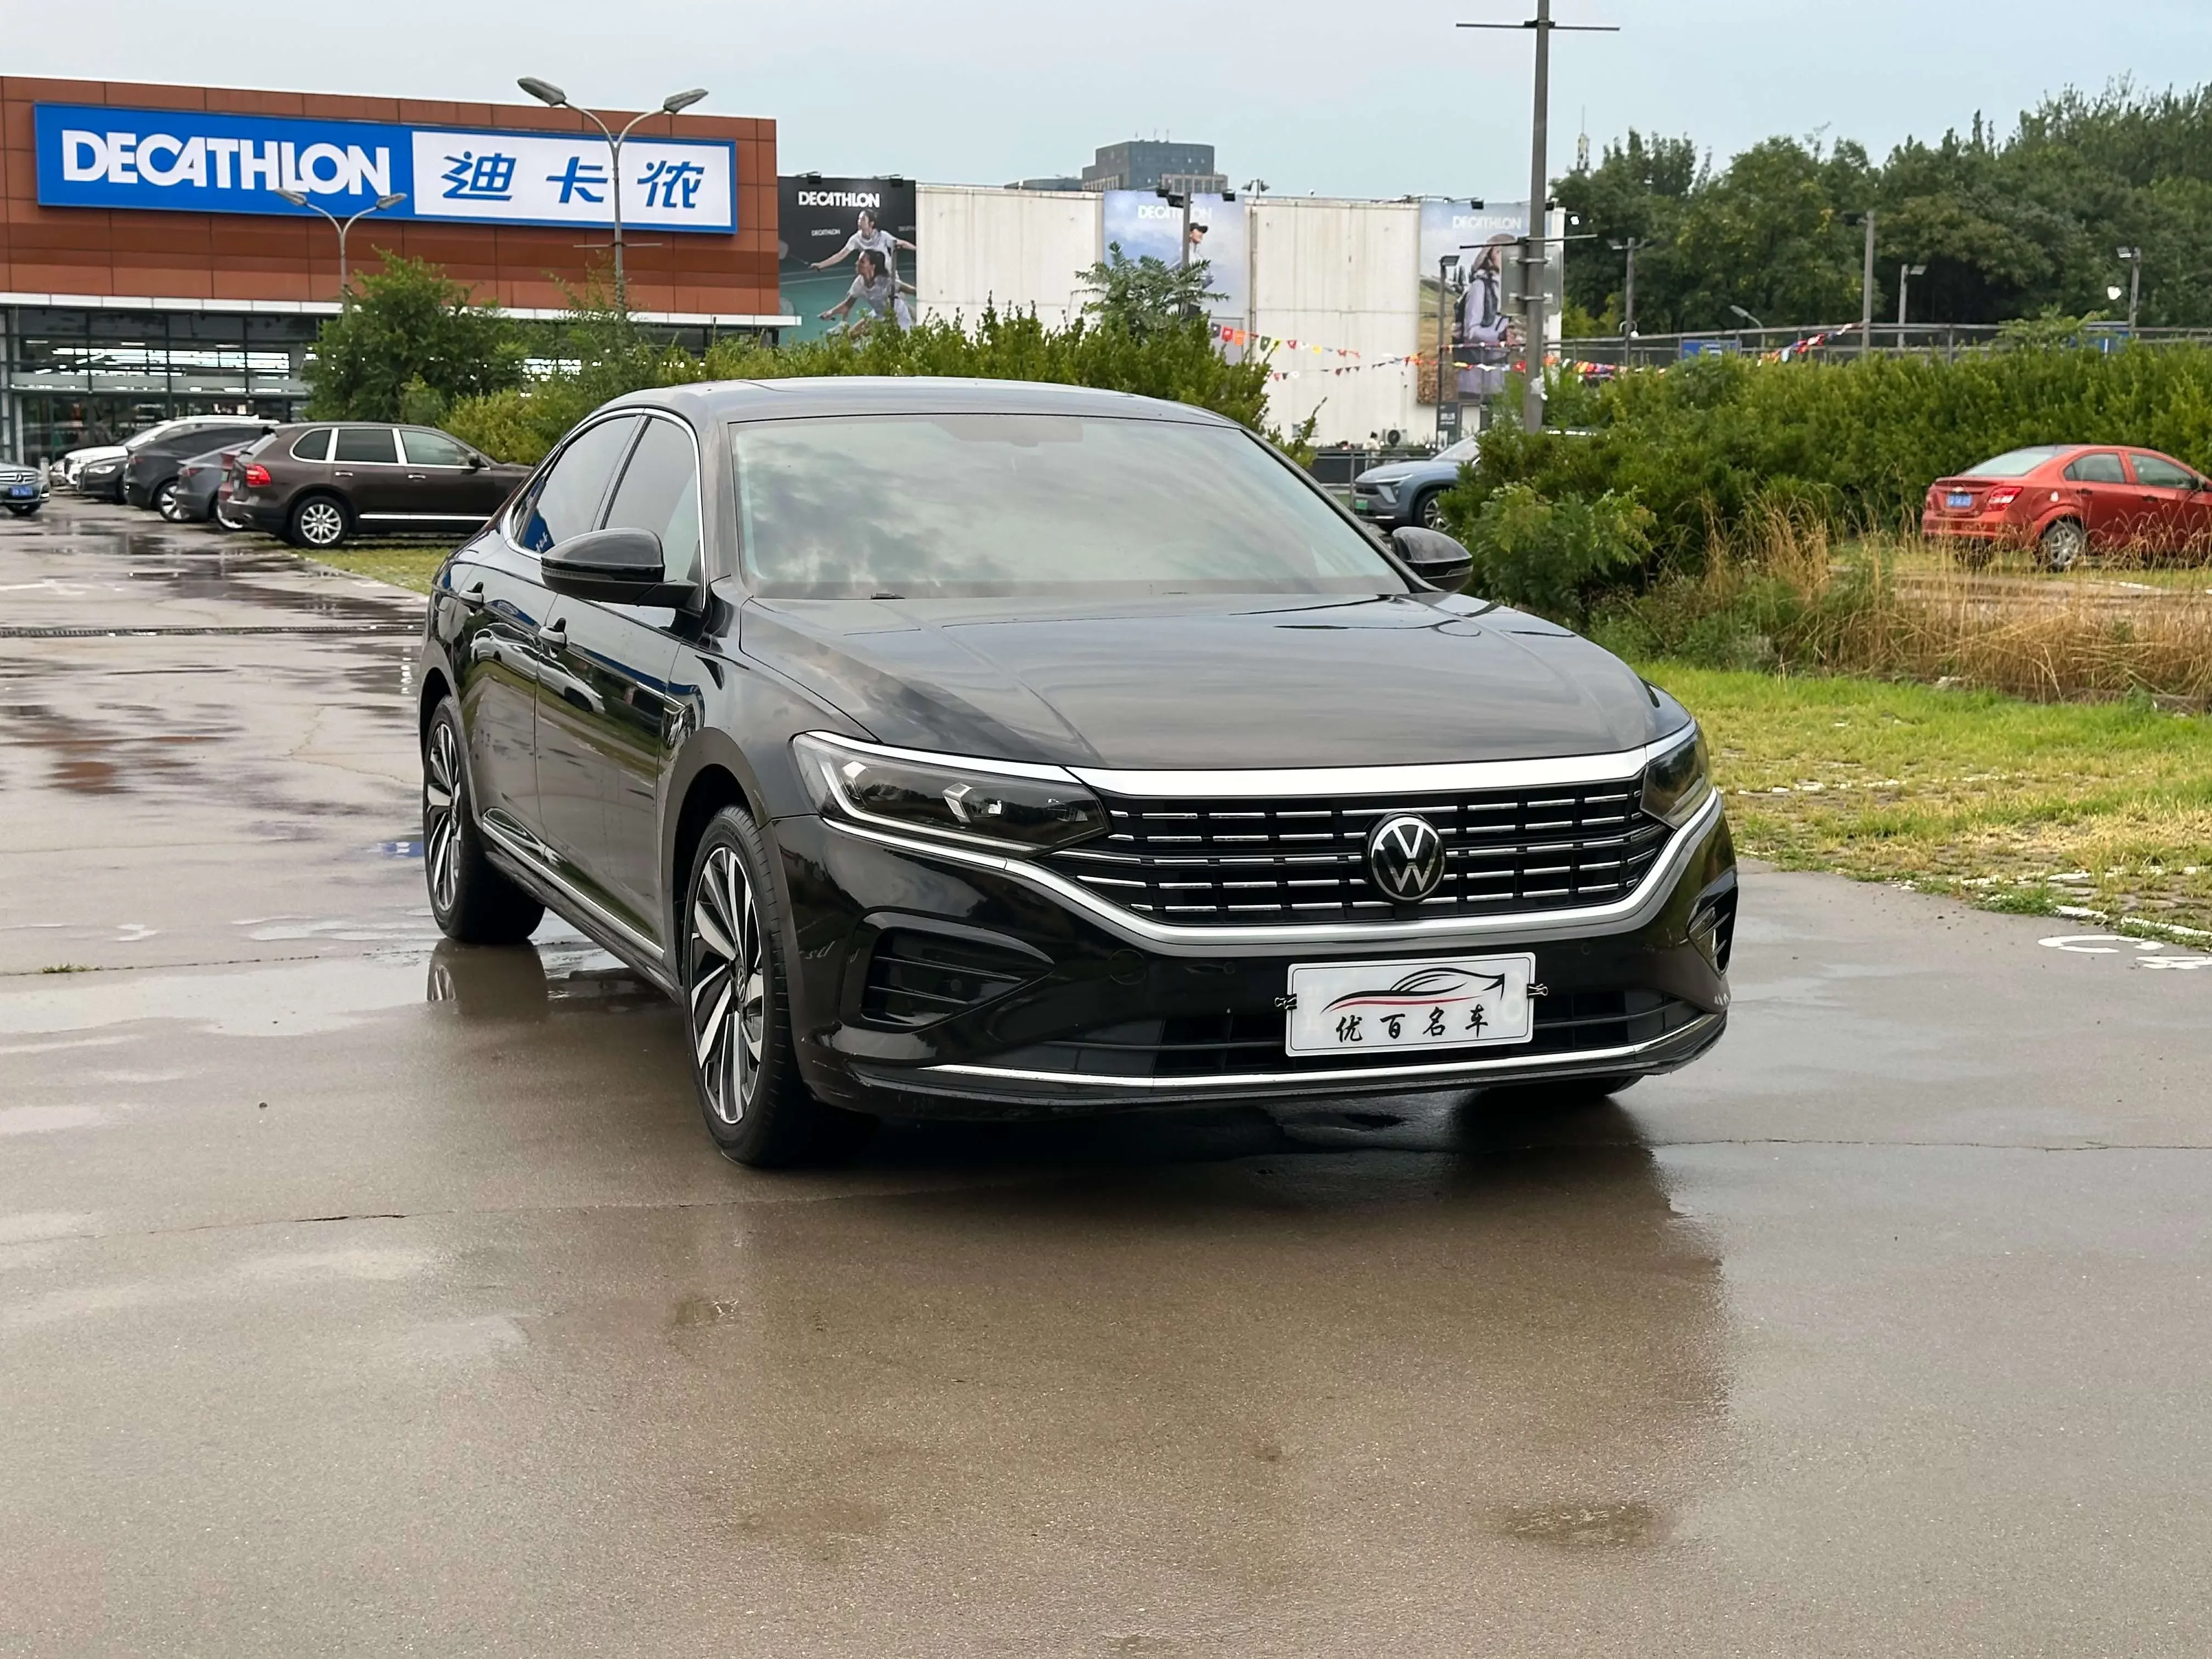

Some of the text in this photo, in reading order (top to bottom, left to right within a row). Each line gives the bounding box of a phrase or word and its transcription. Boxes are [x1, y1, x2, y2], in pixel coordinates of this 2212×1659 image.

[62, 129, 391, 195] DECATHLON
[441, 151, 705, 209] 迪卡侬
[798, 190, 880, 208] DECATHLON
[1453, 215, 1521, 230] DECATHLON
[1336, 1003, 1488, 1043] 优百名车
